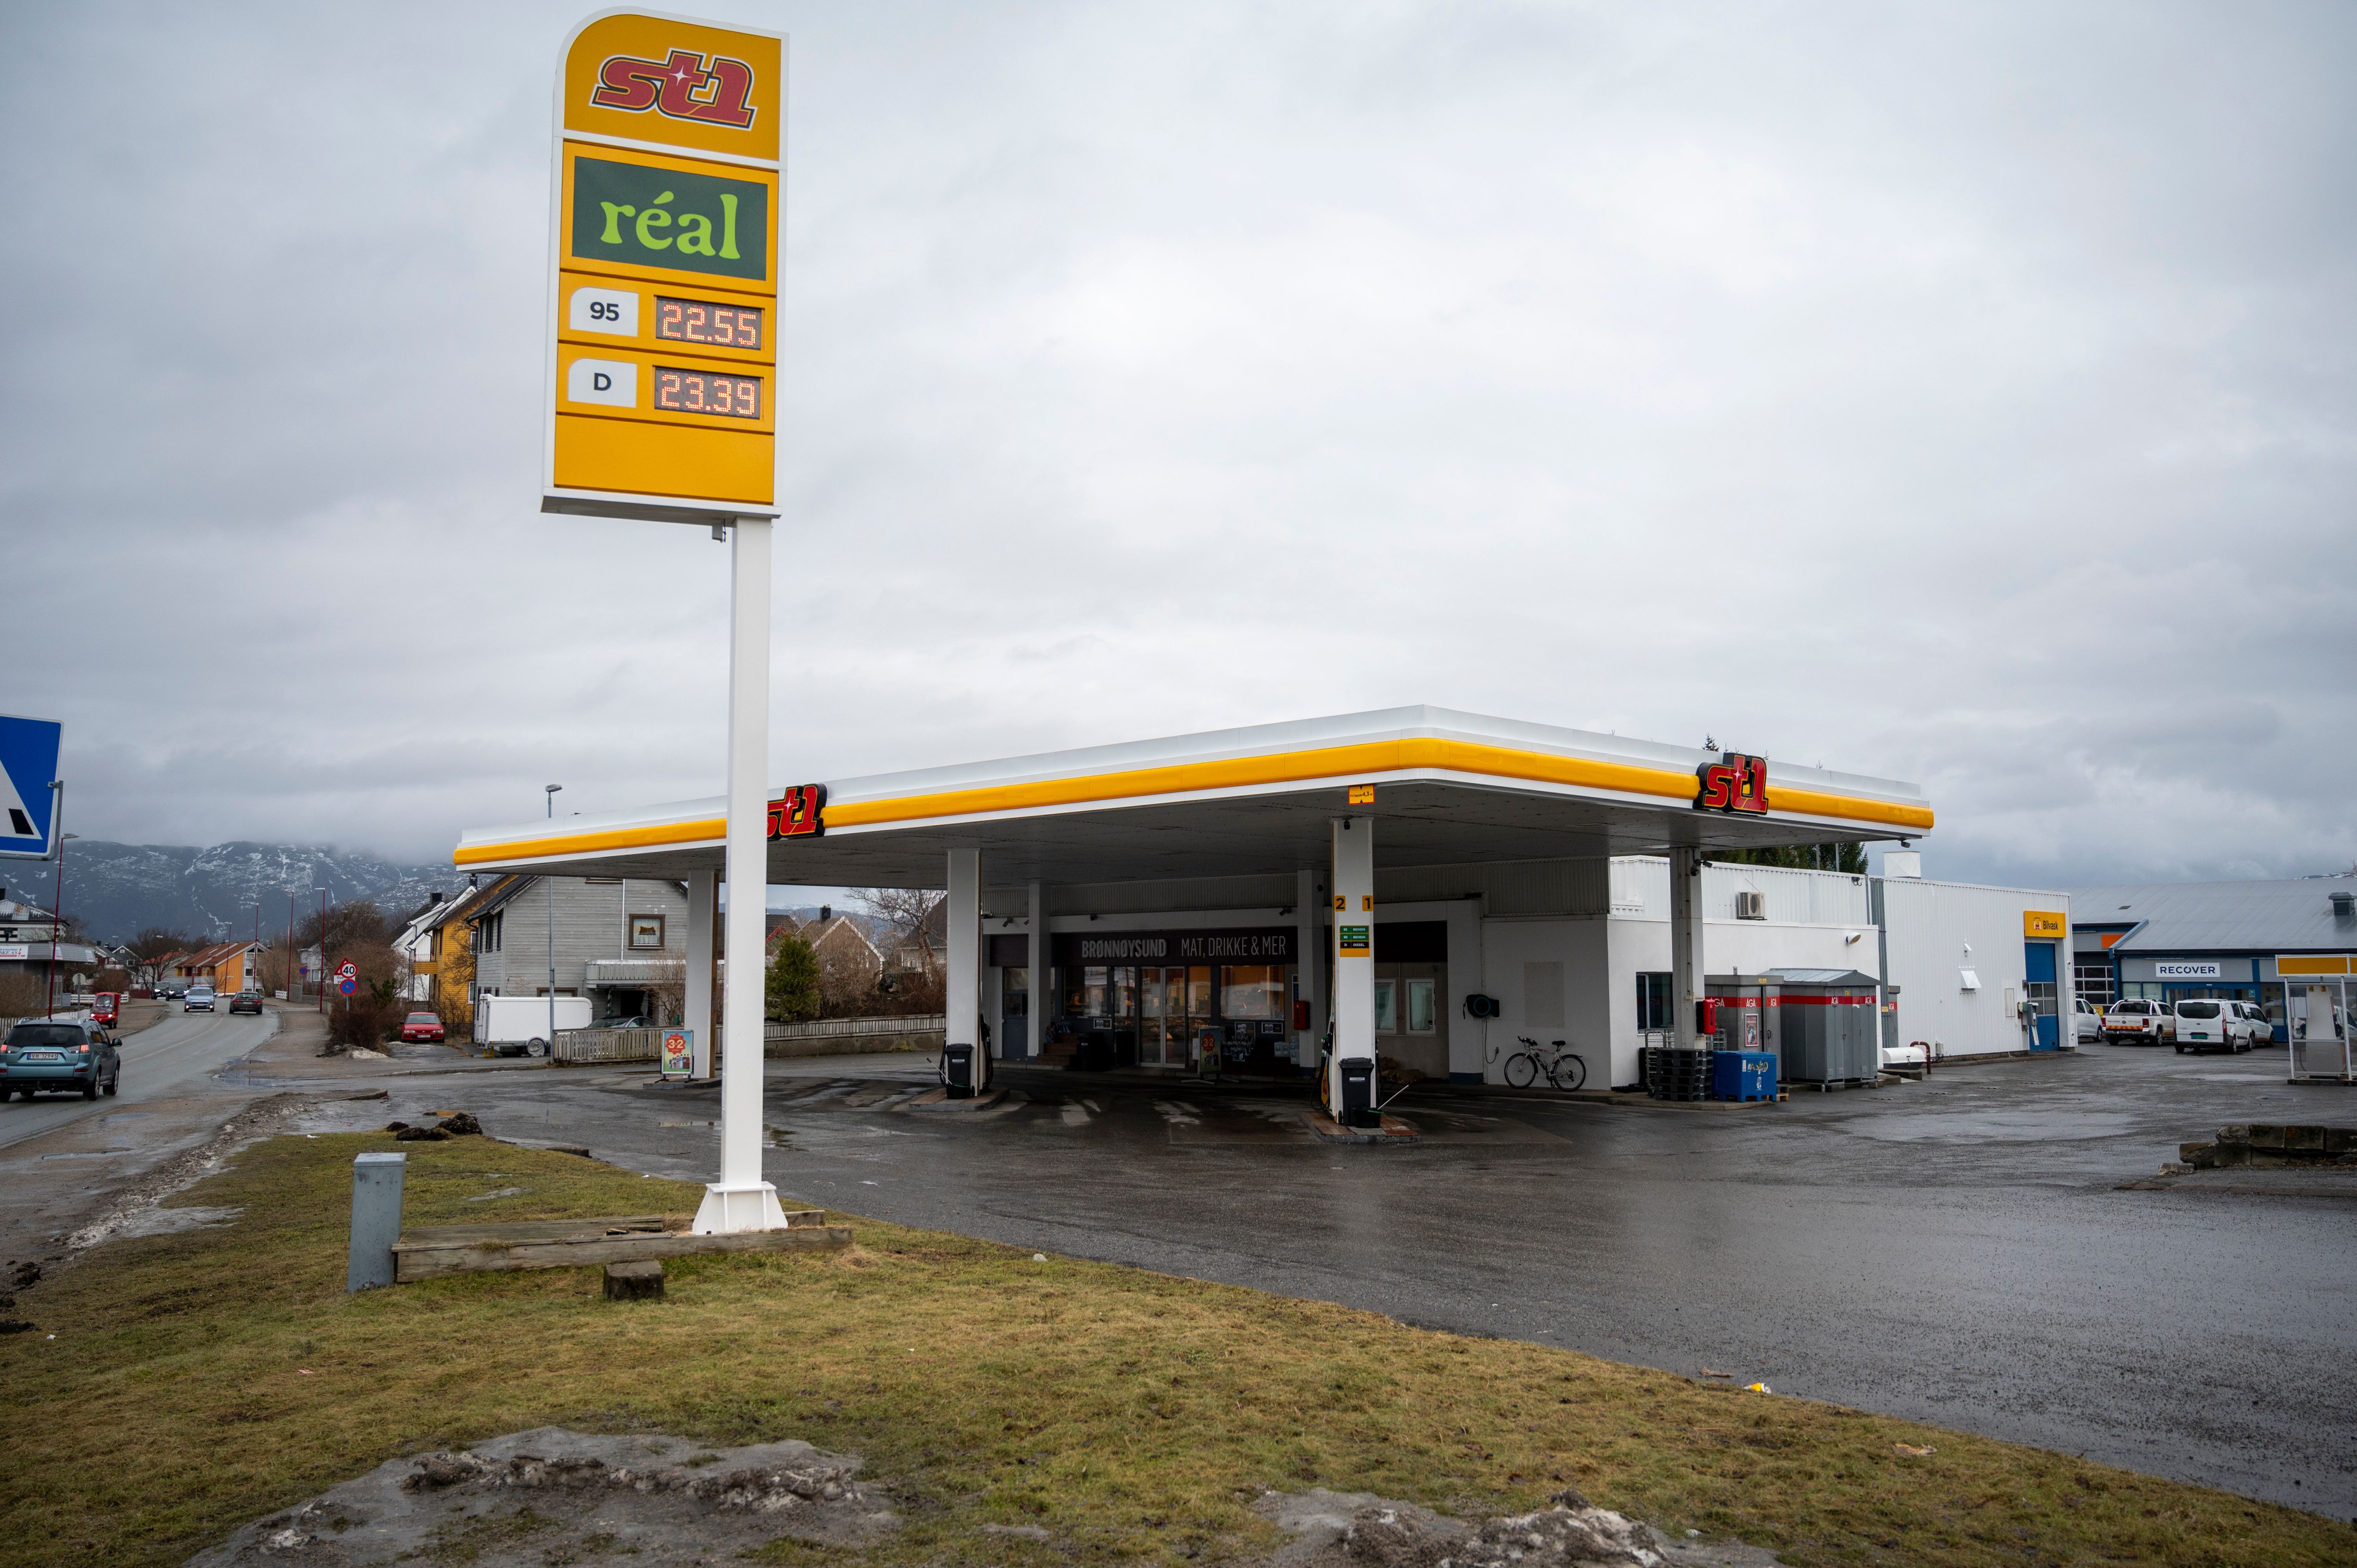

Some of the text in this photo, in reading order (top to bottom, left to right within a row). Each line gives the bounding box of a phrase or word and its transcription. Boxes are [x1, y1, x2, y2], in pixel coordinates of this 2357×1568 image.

[600, 191, 741, 260] réal
[590, 301, 756, 346] 95 22.55
[594, 372, 755, 415] D 23.39
[1336, 897, 1345, 909] 2
[1364, 897, 1370, 909] 1
[2043, 920, 2058, 931] Bilvask
[1082, 935, 1286, 959] BRØNNØYSUND MAT, DRIKKE & MER
[2159, 966, 2216, 974] RECOVER
[1710, 997, 1724, 1007] GA
[1746, 998, 1756, 1007] AGA
